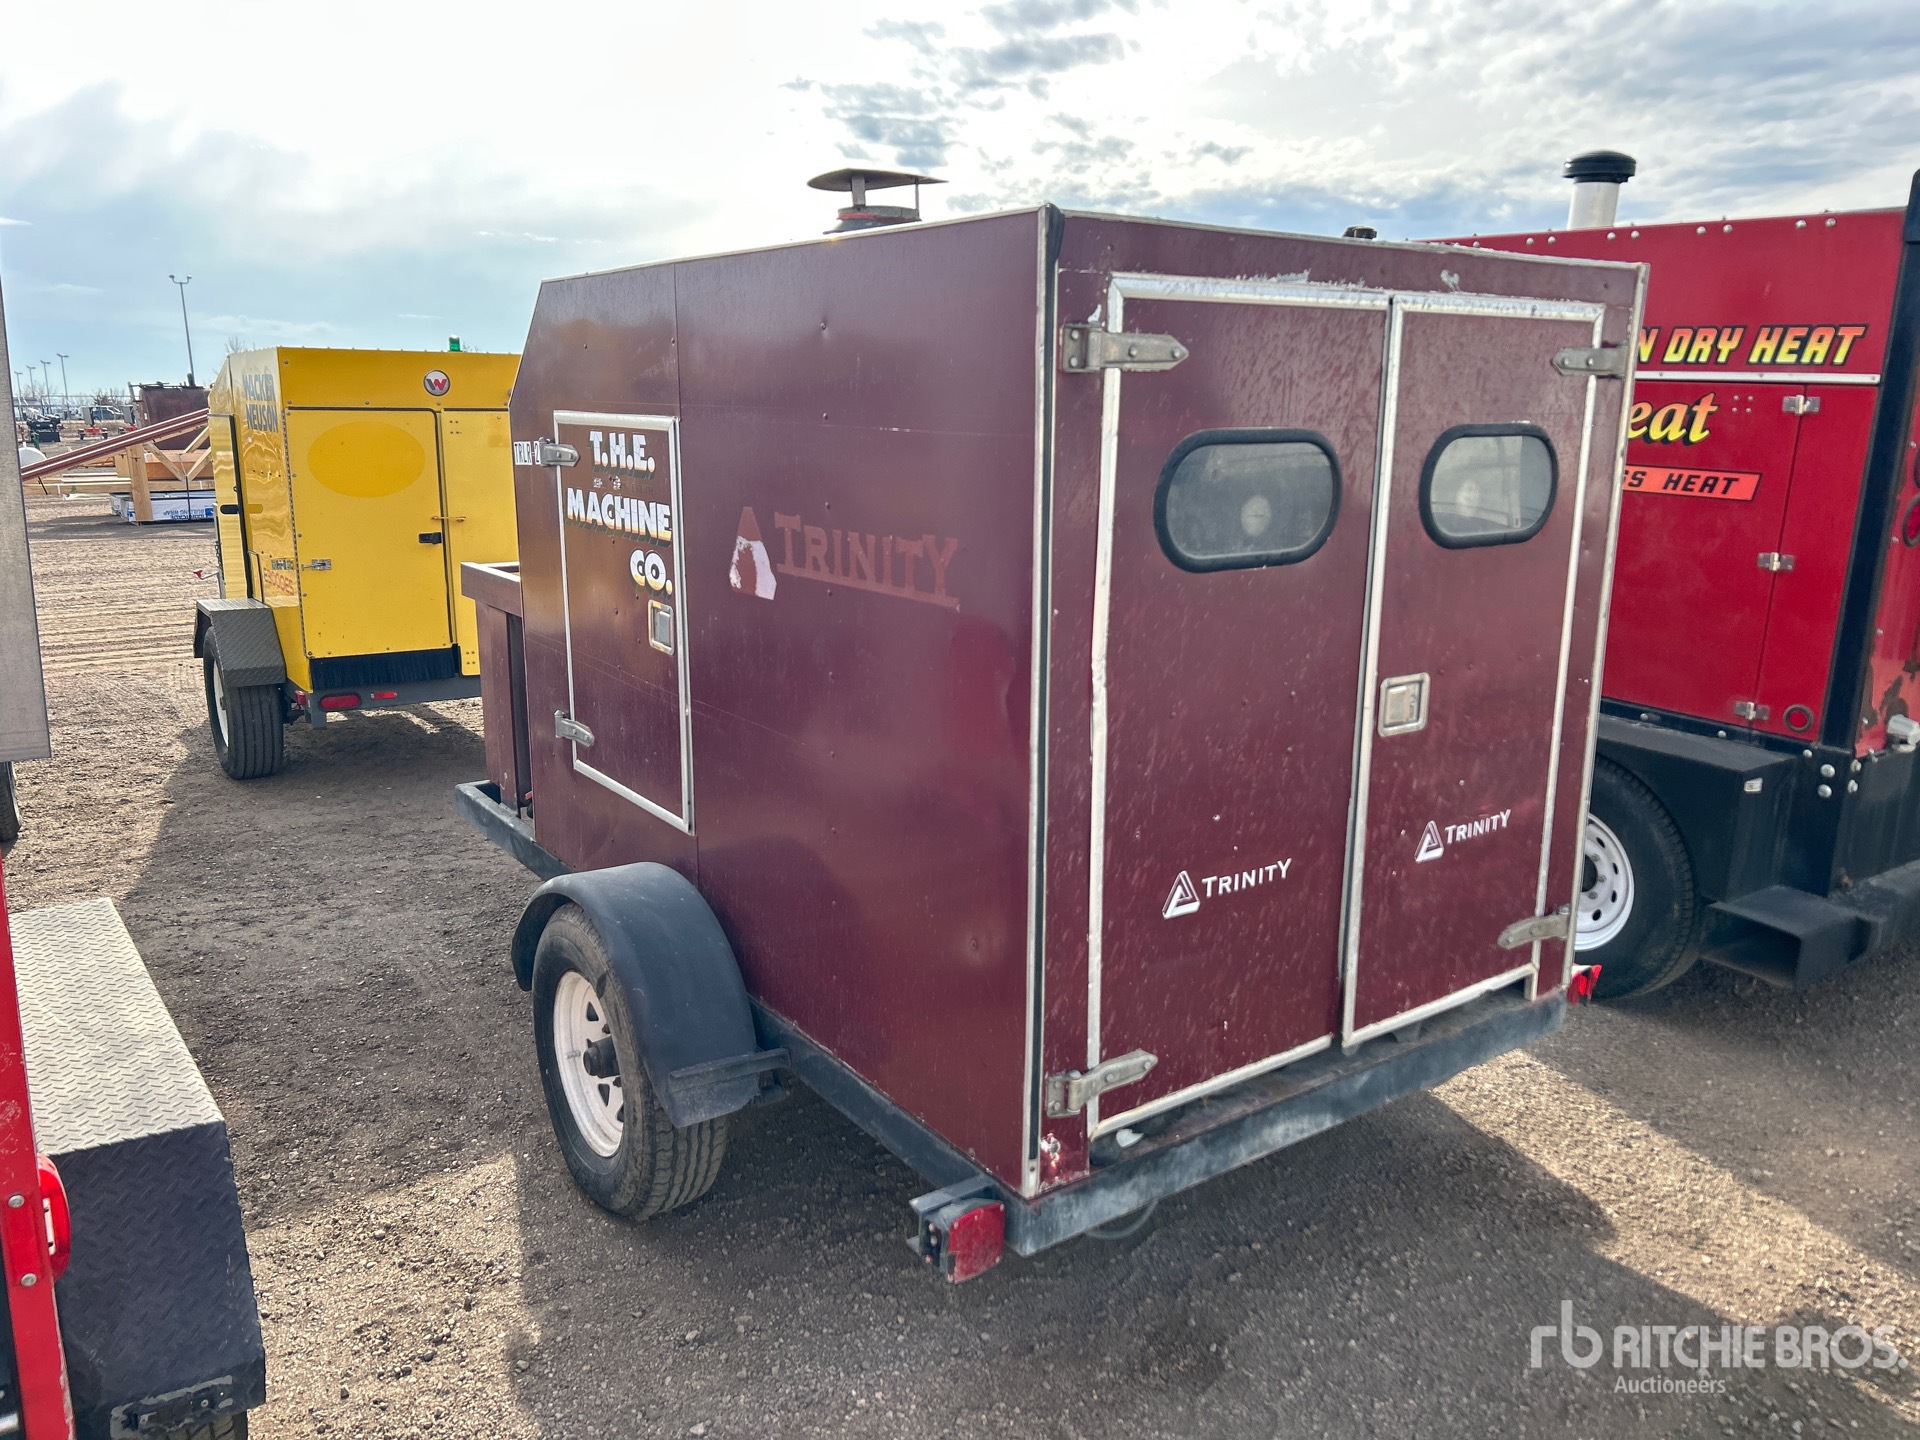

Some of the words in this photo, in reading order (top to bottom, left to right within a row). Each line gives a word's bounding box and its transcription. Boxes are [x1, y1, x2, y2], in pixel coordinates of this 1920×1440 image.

[1662, 327, 1746, 364] DRY
[1748, 326, 1867, 365] HEAT
[242, 374, 277, 402] WACKER
[246, 404, 279, 433] NEUSON
[1627, 392, 1719, 443] eat
[588, 430, 656, 474] T.H.E.
[1662, 472, 1739, 495] HEAT
[566, 487, 672, 543] MACHINE
[629, 549, 673, 596] CO.
[774, 511, 958, 598] TRINITY
[1444, 808, 1511, 845] TRINITY
[1201, 857, 1293, 898] TRINITY
